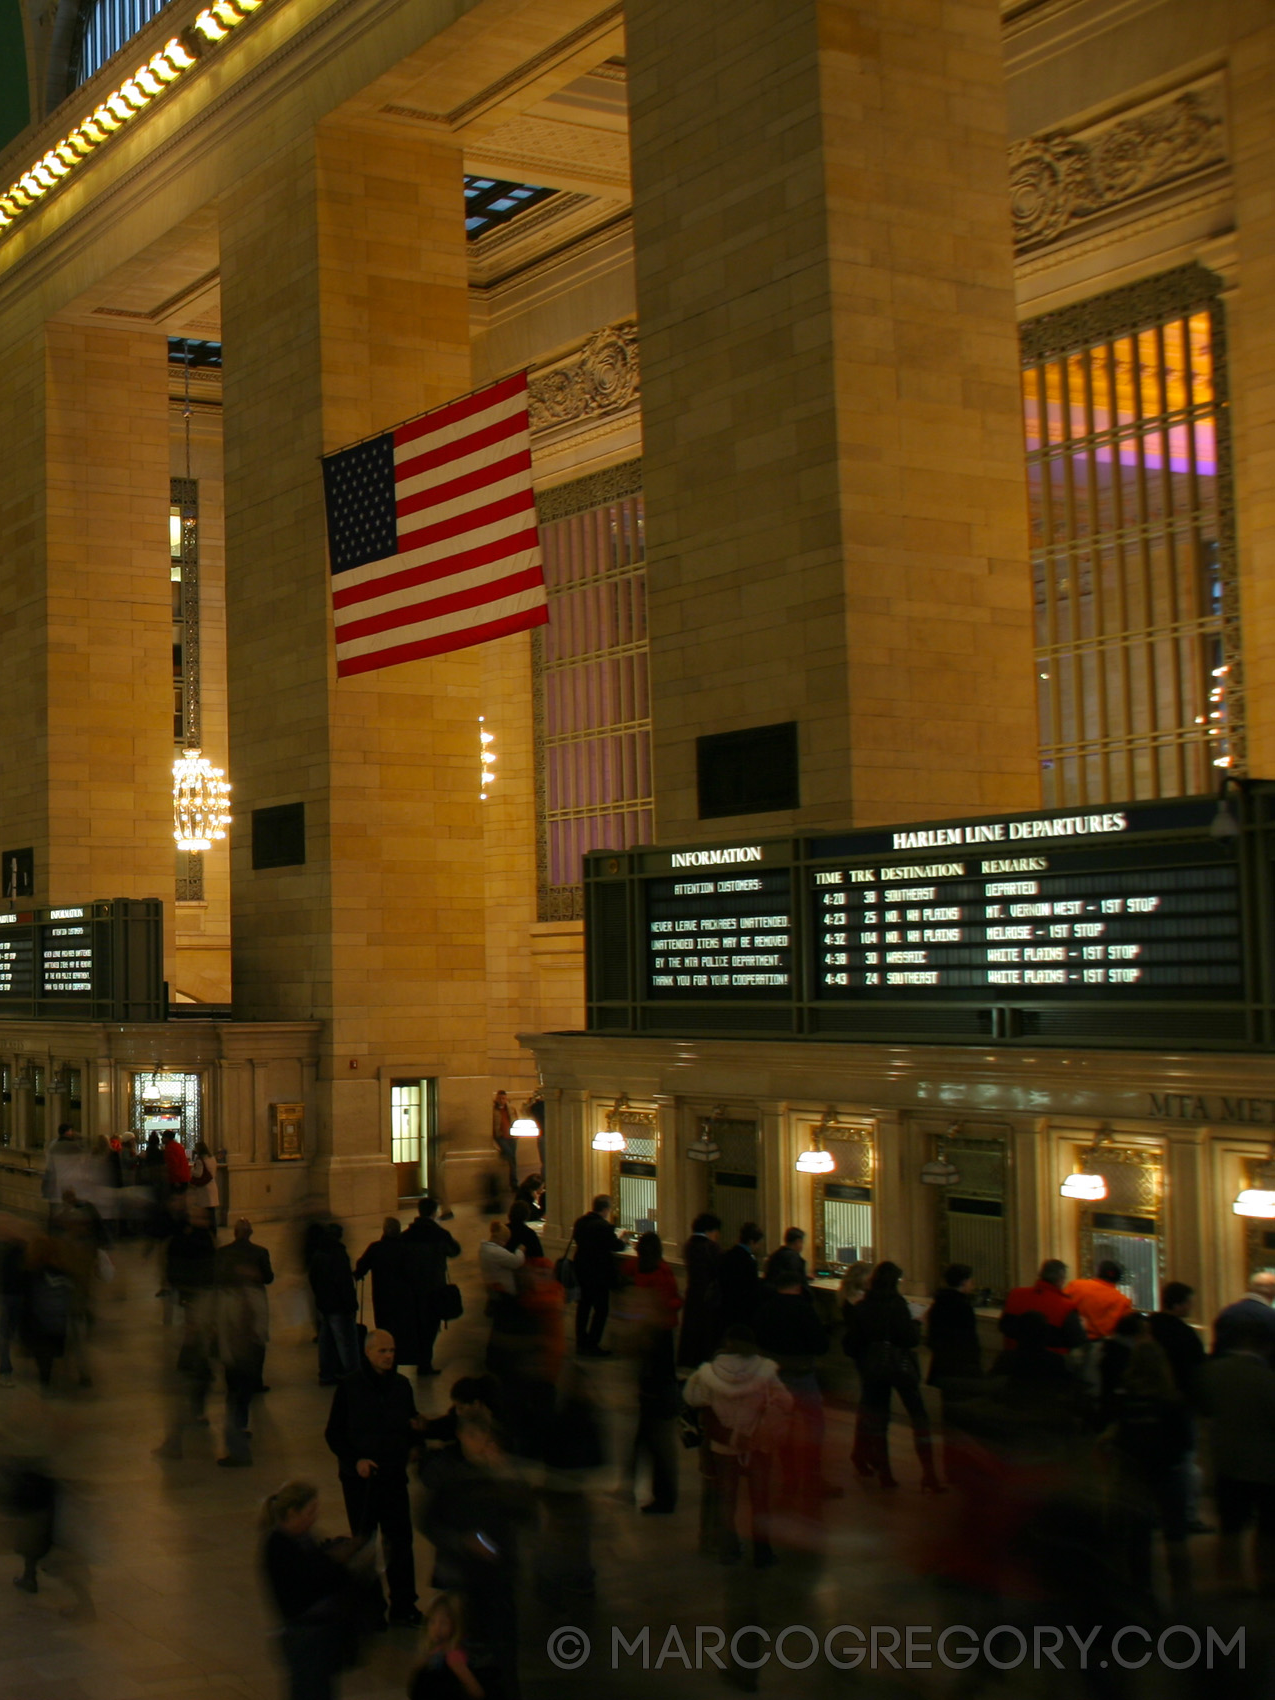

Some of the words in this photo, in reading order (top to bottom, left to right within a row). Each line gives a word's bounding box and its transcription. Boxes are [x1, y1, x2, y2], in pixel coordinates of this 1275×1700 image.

[893, 828, 962, 849] HARLEM
[965, 824, 1006, 843] LINE
[1009, 812, 1127, 840] DEPARTURES
[671, 846, 763, 868] INFORMATION
[815, 872, 843, 884] TIME
[849, 870, 875, 882] TRK
[881, 862, 965, 880] DESTINATION
[981, 857, 1047, 874] REMARKS
[675, 882, 714, 895] ATTENTION
[717, 879, 763, 892] CUSTOMERS:
[823, 893, 846, 905] 4:20
[884, 887, 936, 902] SOUTHEAST
[985, 881, 1039, 896] DEPARTED
[823, 913, 847, 925] 4:23
[923, 907, 961, 921] PLAINS
[985, 905, 1005, 918] MT.
[1009, 903, 1051, 917] VERNON
[1053, 901, 1083, 916] WEST
[1101, 899, 1124, 914] 1ST
[1127, 896, 1160, 913] STOP
[651, 921, 673, 932] NEVER
[675, 920, 697, 932] LEAVE
[701, 918, 737, 930] PACKAGES
[823, 933, 847, 945] 4:32
[861, 932, 878, 944] 104
[923, 928, 961, 942] PLAINS
[986, 926, 1033, 940] MELROSE
[1049, 924, 1070, 938] 1ST
[1074, 923, 1105, 937] STOP
[651, 938, 694, 950] UNATTENDED
[697, 938, 719, 949] ITEMS
[723, 937, 737, 948] MAY
[741, 936, 751, 947] BE
[754, 935, 789, 947] REMOVED
[655, 957, 664, 968] BY
[668, 957, 681, 968] THE
[684, 956, 698, 967] MTA
[701, 956, 729, 967] POLICE
[732, 955, 783, 967] DEPARTMENT.
[886, 951, 927, 964] WASSAIC
[987, 948, 1021, 962] WHITE
[1024, 947, 1067, 961] PLAINS
[1083, 946, 1105, 960] 1ST
[1108, 944, 1140, 959] STOP
[652, 975, 673, 986] THANK
[676, 975, 690, 986] YOU
[693, 975, 708, 986] FOR
[711, 975, 729, 985] YOUR
[732, 974, 788, 985] COOPERATION!
[825, 973, 848, 985] 4:43
[887, 971, 939, 985] SOUTHEAST
[987, 970, 1022, 984] WHITE
[1024, 970, 1067, 983] PLAINS
[1083, 969, 1105, 983] 1ST
[1108, 968, 1141, 983] STOP
[1149, 1092, 1213, 1120] MTA
